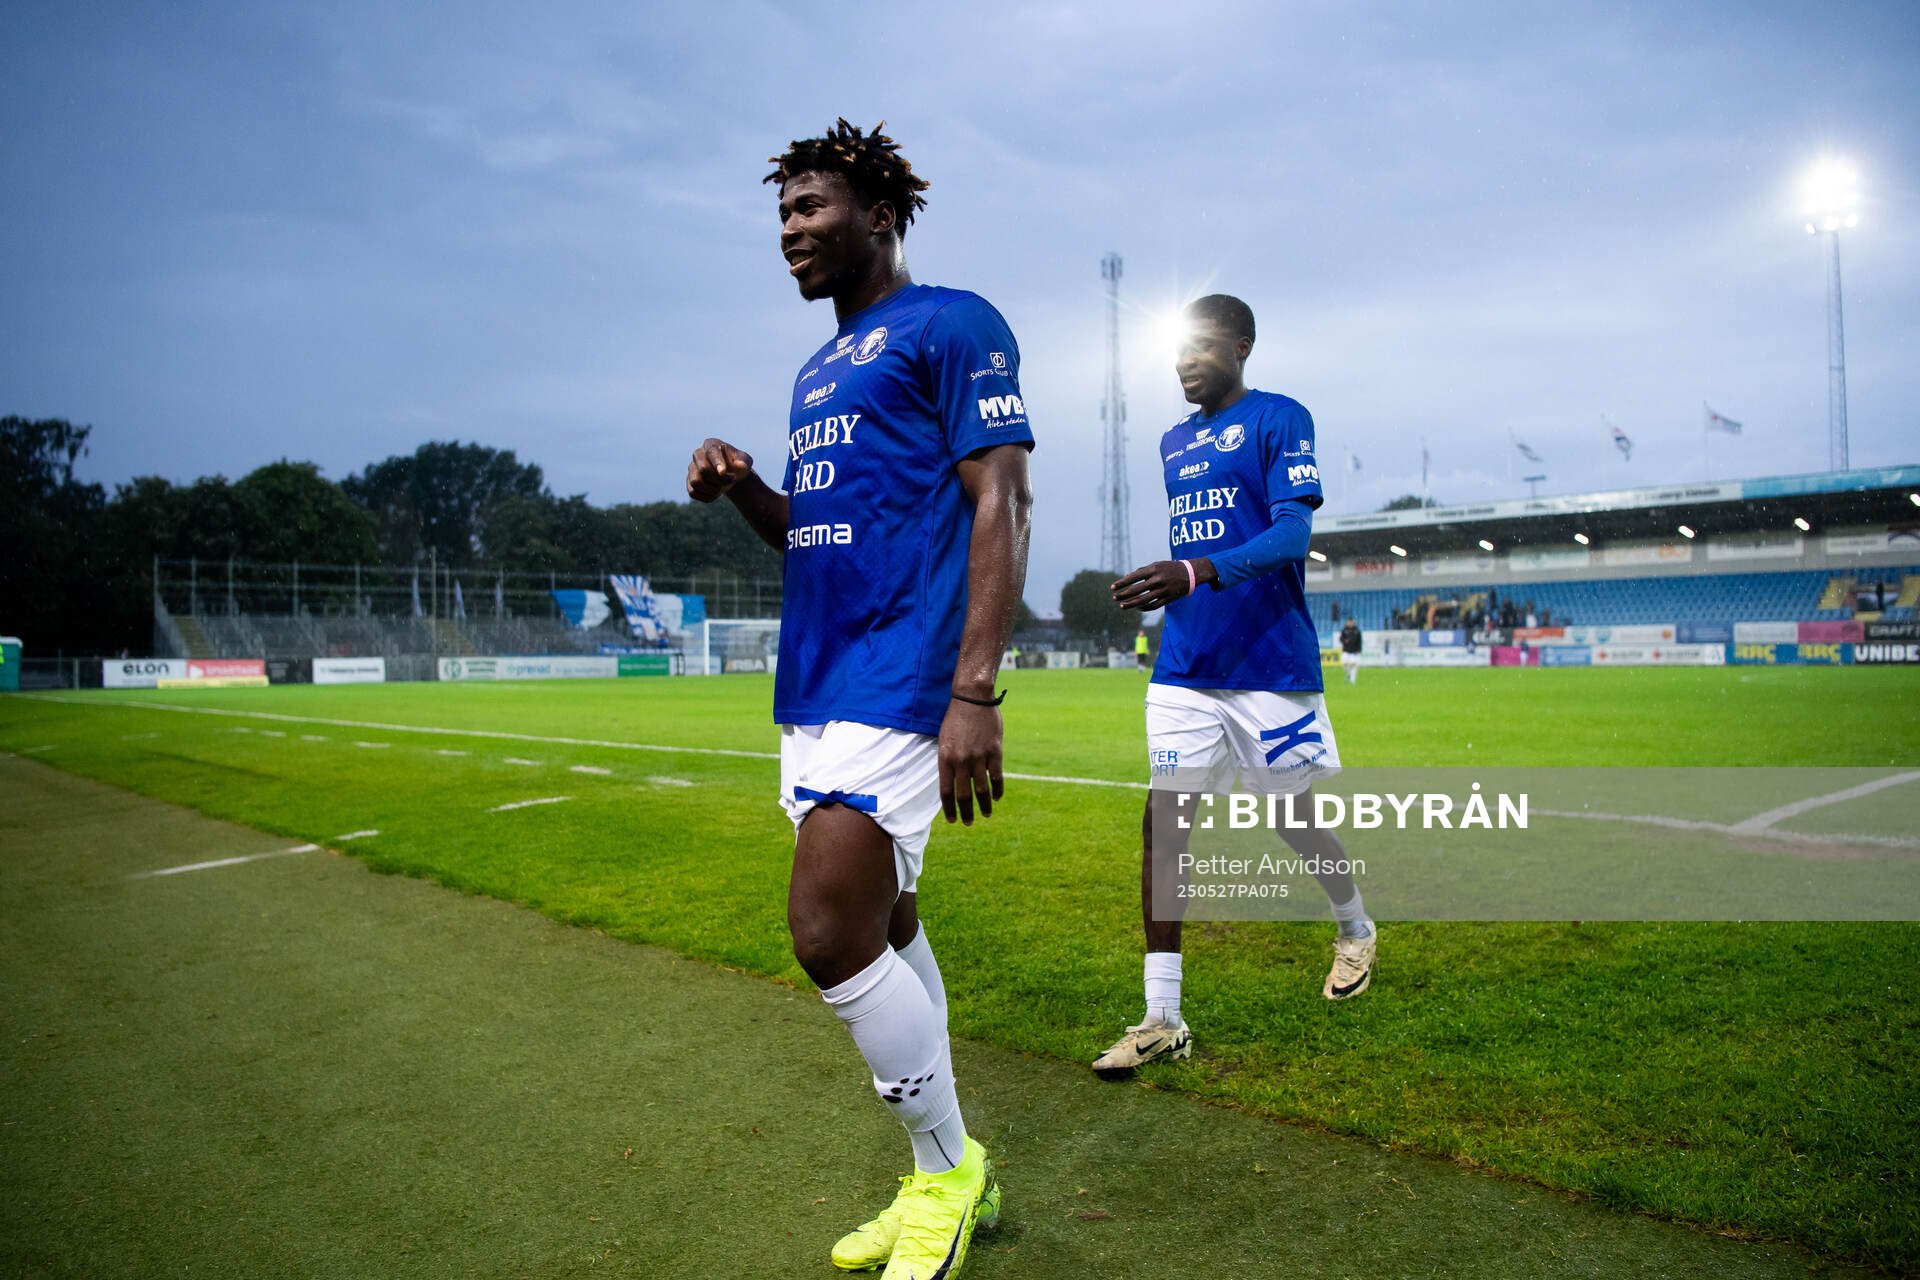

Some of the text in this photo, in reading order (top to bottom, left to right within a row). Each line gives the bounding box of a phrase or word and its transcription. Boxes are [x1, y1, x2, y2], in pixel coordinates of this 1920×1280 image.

[1287, 464, 1319, 481] MVB
[1171, 517, 1225, 547] GÅRD
[1855, 644, 1920, 662] UNIBE
